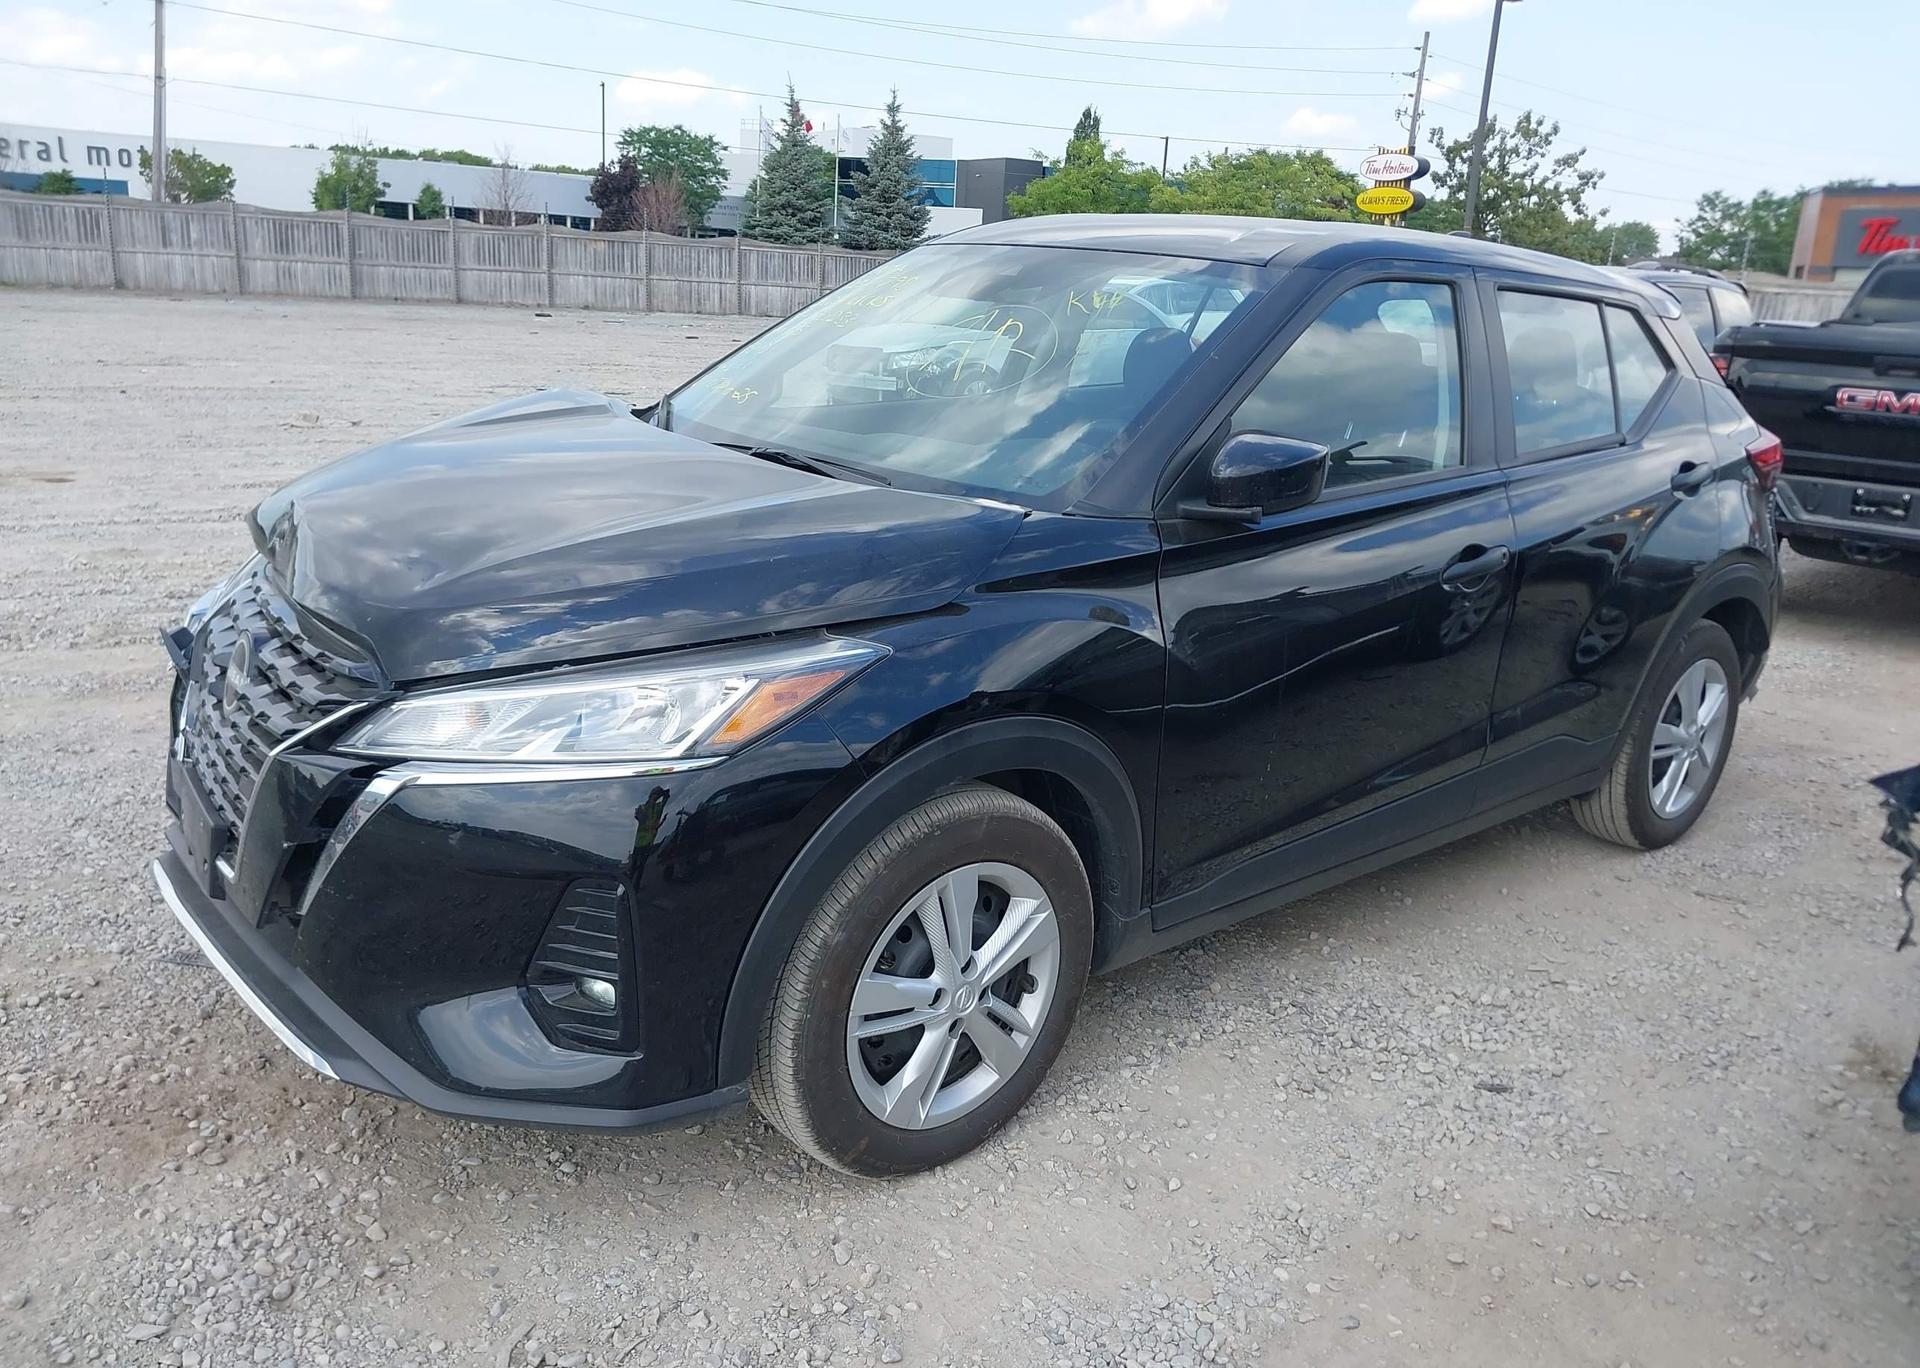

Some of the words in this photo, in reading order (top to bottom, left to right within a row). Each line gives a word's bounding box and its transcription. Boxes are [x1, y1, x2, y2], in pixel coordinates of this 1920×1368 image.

[1365, 160, 1381, 175] Tim
[1359, 196, 1386, 206] ALWAYS
[1386, 195, 1410, 205] FRESH
